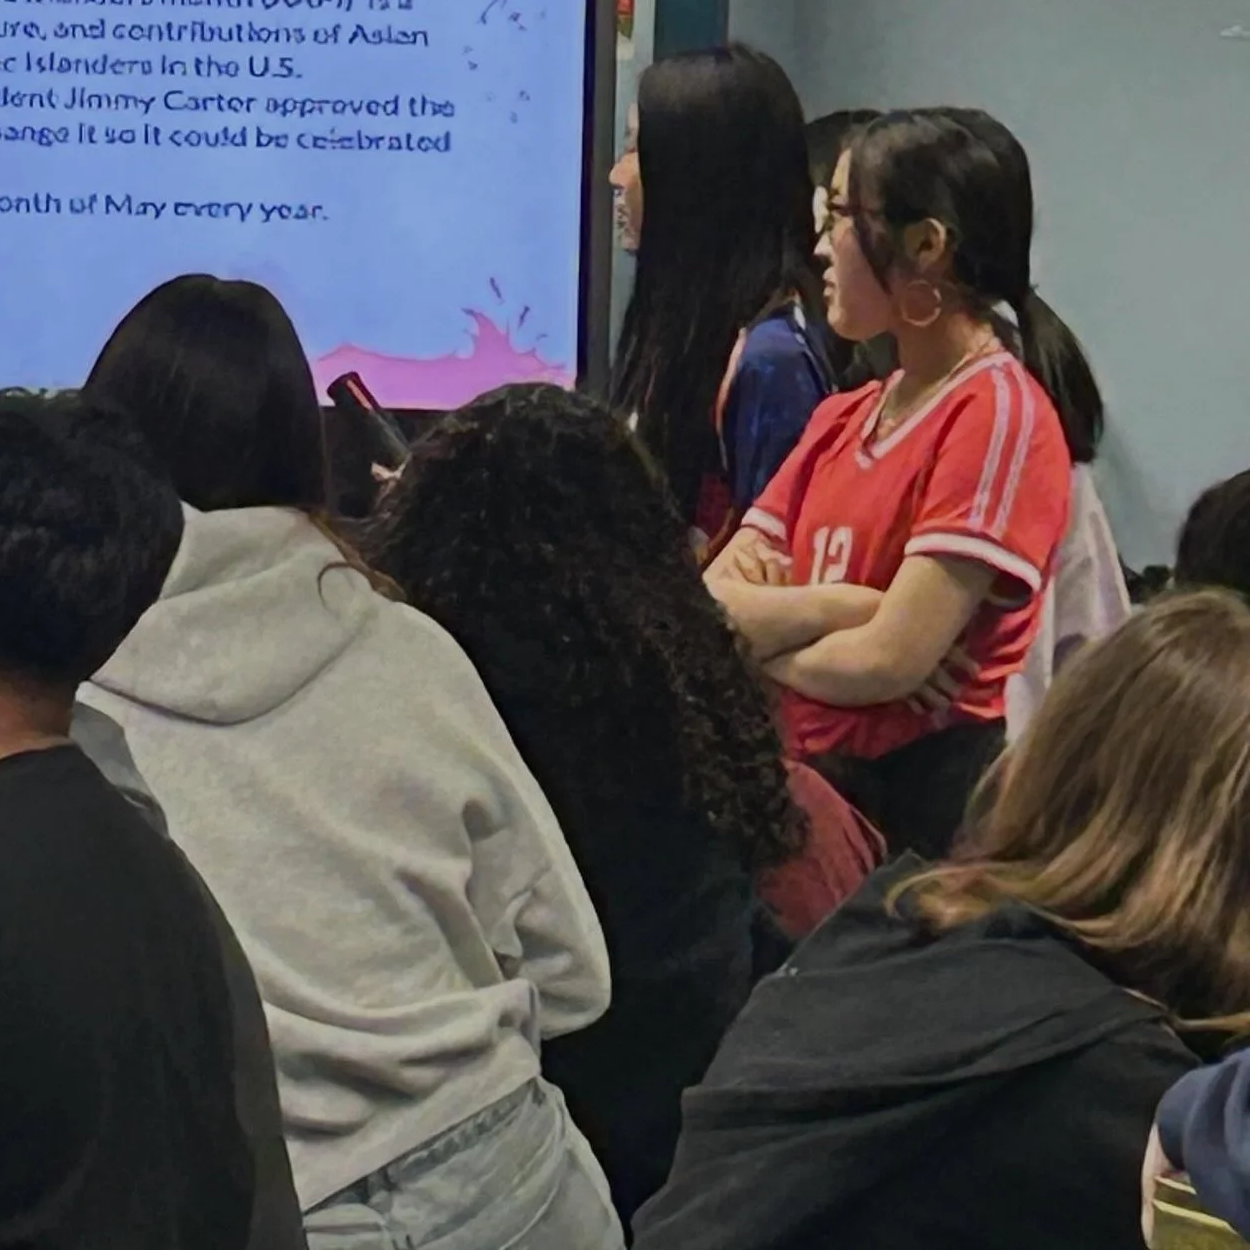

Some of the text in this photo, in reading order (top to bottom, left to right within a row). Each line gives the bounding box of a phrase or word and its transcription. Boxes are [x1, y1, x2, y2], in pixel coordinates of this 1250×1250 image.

[54, 18, 105, 40] and
[112, 20, 306, 45] contributions
[313, 23, 341, 45] of
[348, 24, 429, 47] Asian
[26, 51, 152, 76] Islanders
[161, 54, 186, 76] in
[194, 56, 240, 78] the
[249, 56, 303, 79] U.S.
[64, 87, 156, 114] Jimmy
[164, 90, 257, 113] Carter
[266, 94, 399, 118] approved
[409, 95, 455, 118] the
[169, 126, 247, 147] could
[256, 126, 288, 149] be
[69, 193, 97, 214] of
[105, 193, 166, 219] May
[174, 201, 252, 223] every
